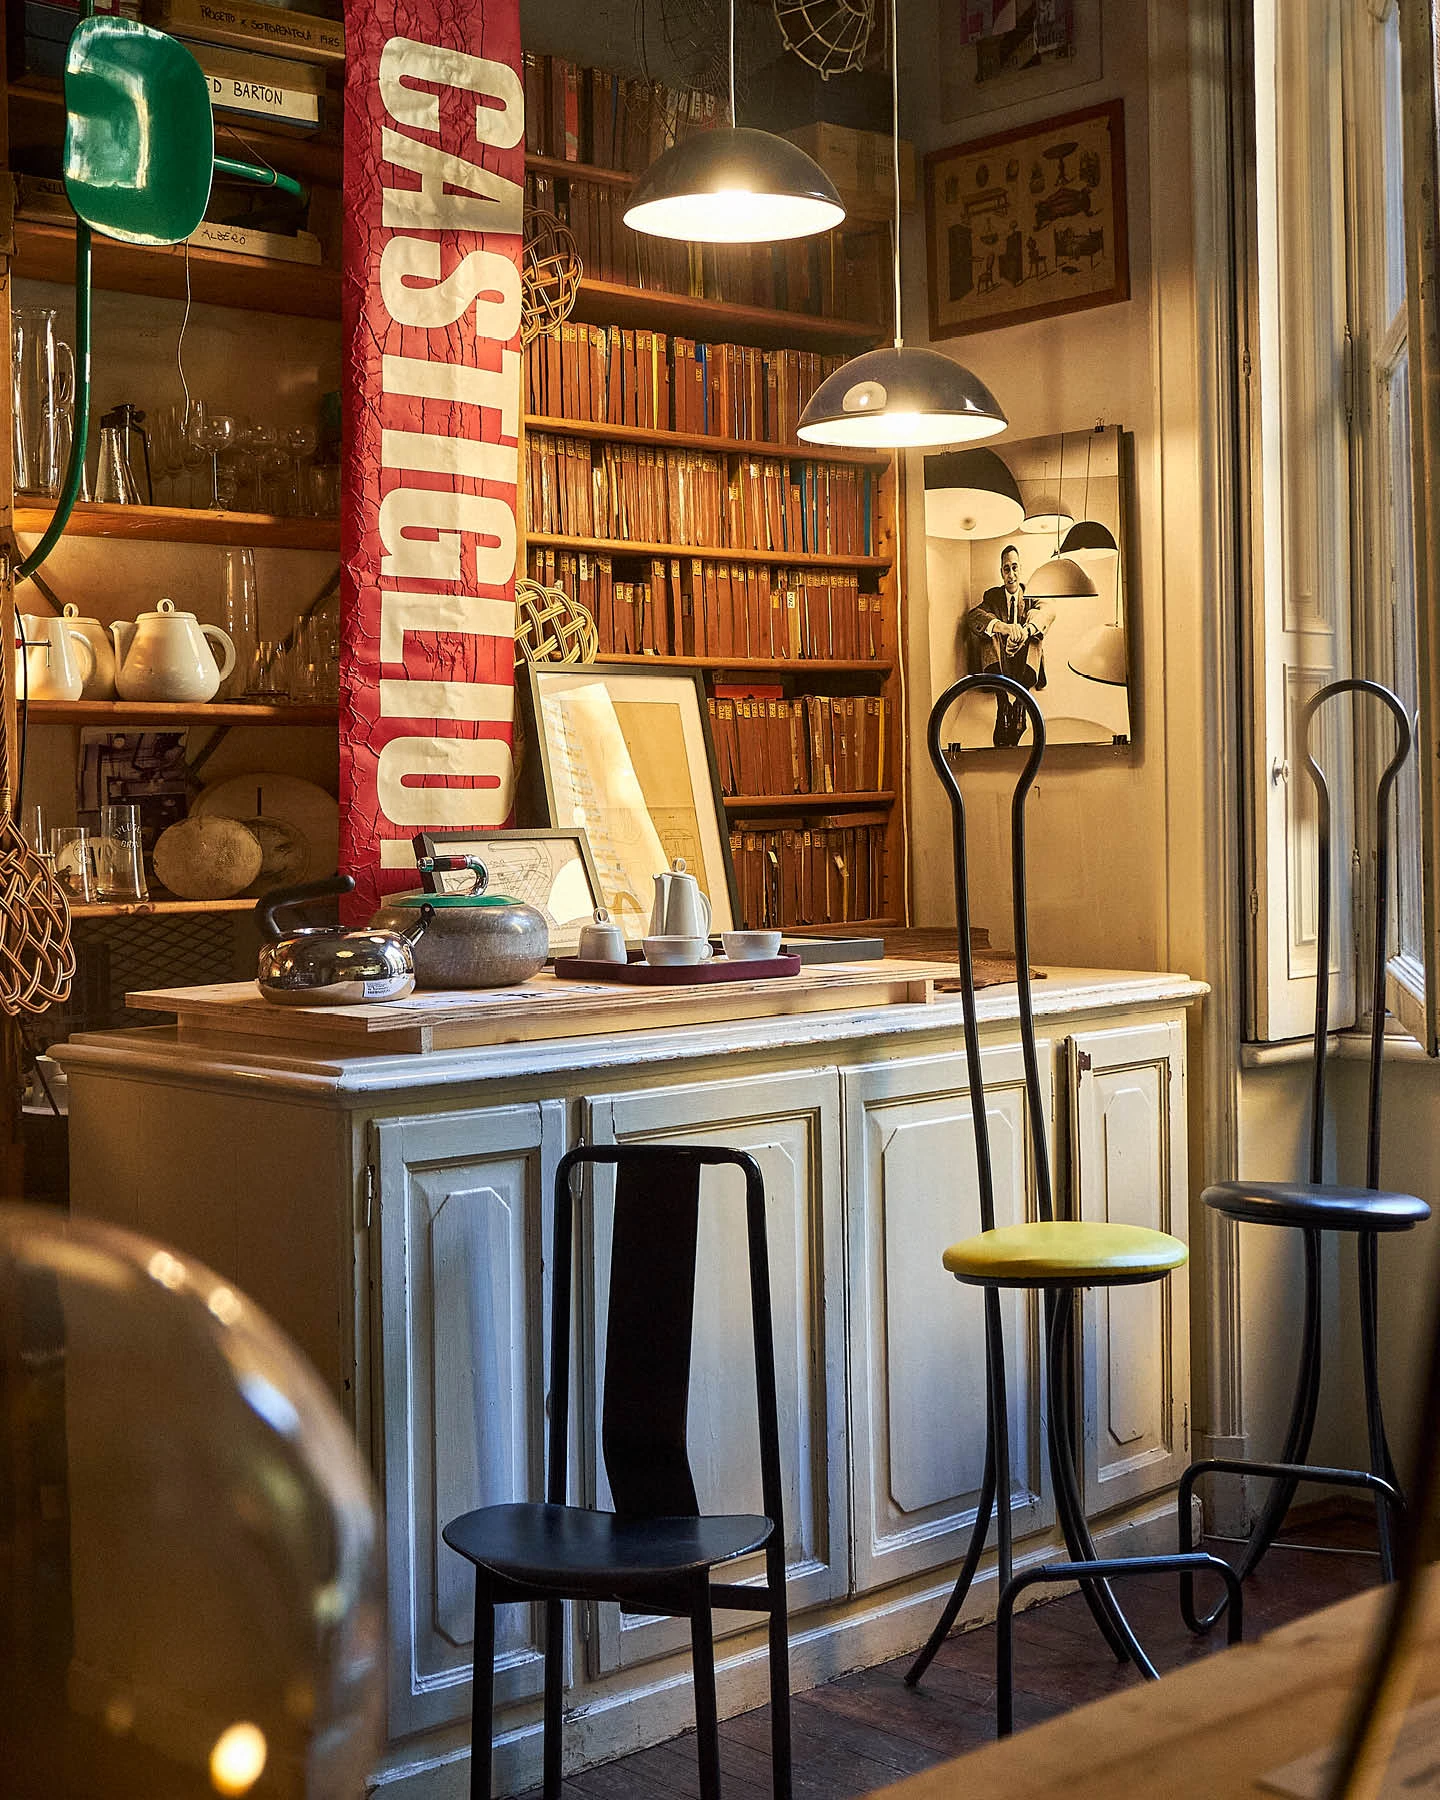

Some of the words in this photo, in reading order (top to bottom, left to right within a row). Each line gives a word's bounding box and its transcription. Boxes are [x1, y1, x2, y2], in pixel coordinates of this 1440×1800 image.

[233, 81, 283, 105] BARTON
[201, 229, 246, 245] ALBERO
[377, 36, 524, 906] CASTIGLIO
